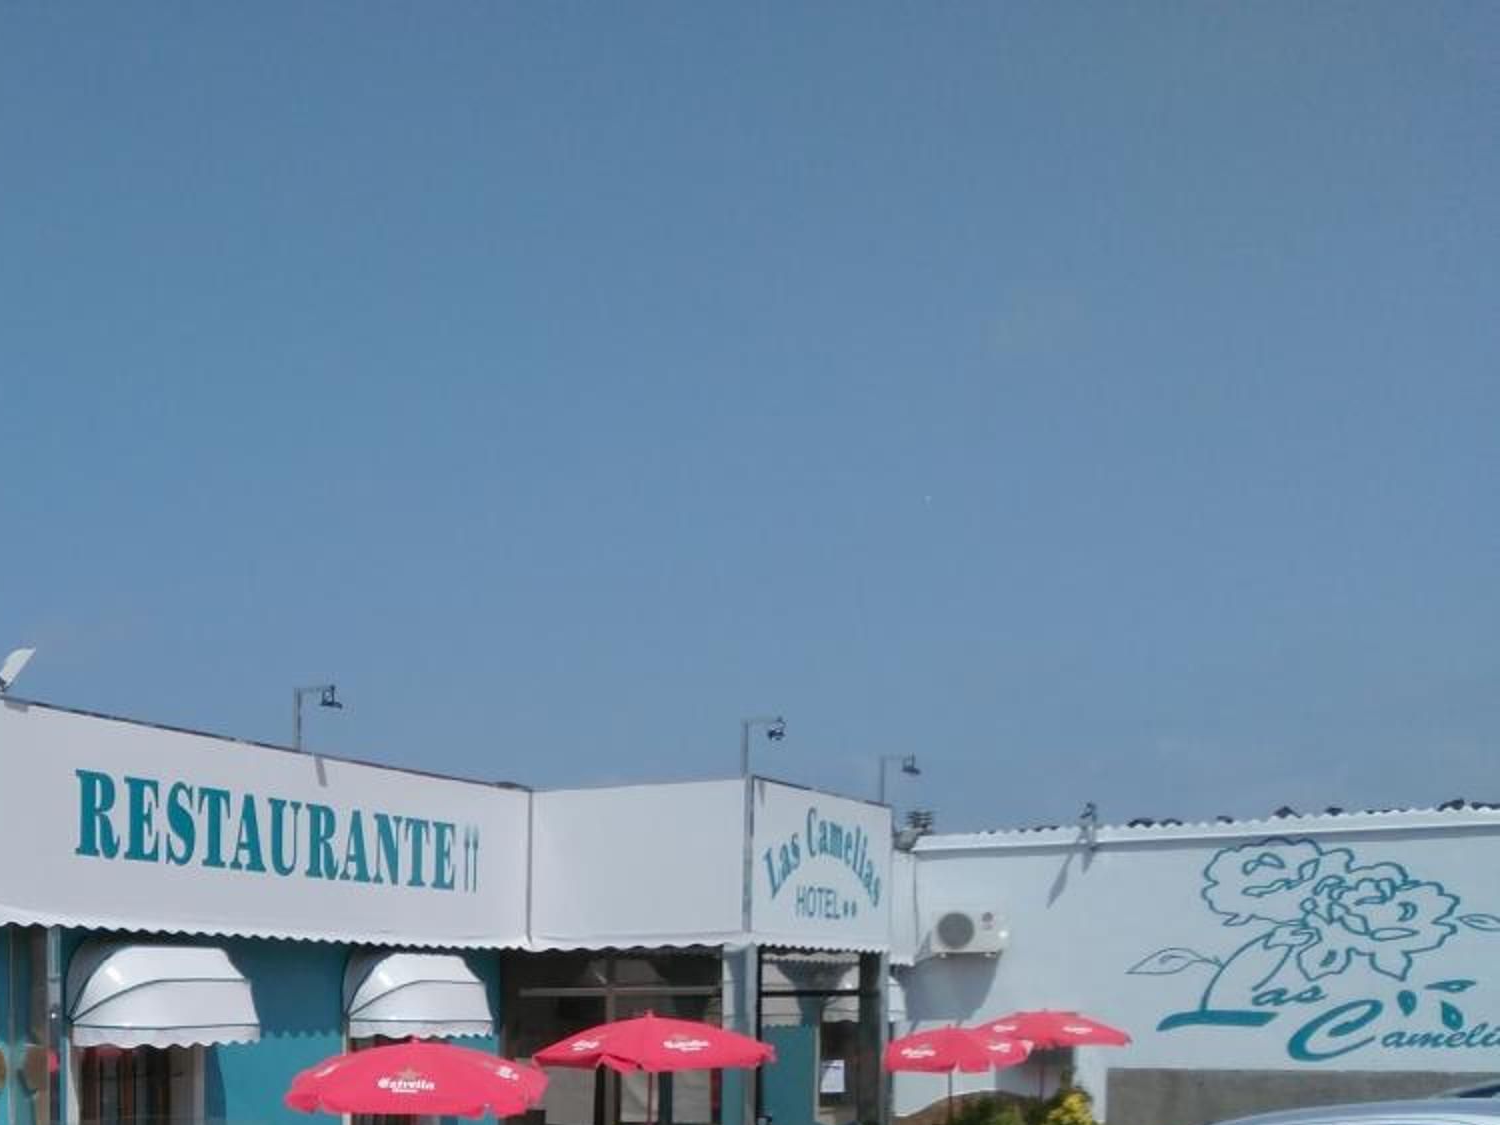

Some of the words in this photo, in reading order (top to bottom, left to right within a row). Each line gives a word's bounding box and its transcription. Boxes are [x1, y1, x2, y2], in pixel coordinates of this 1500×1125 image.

[75, 769, 456, 890] RESTAURANTE
[763, 832, 800, 899] Las
[806, 807, 880, 908] Camelias
[795, 886, 841, 919] HOTEL
[1156, 942, 1326, 1031] Las
[1287, 999, 1500, 1061] Cameli
